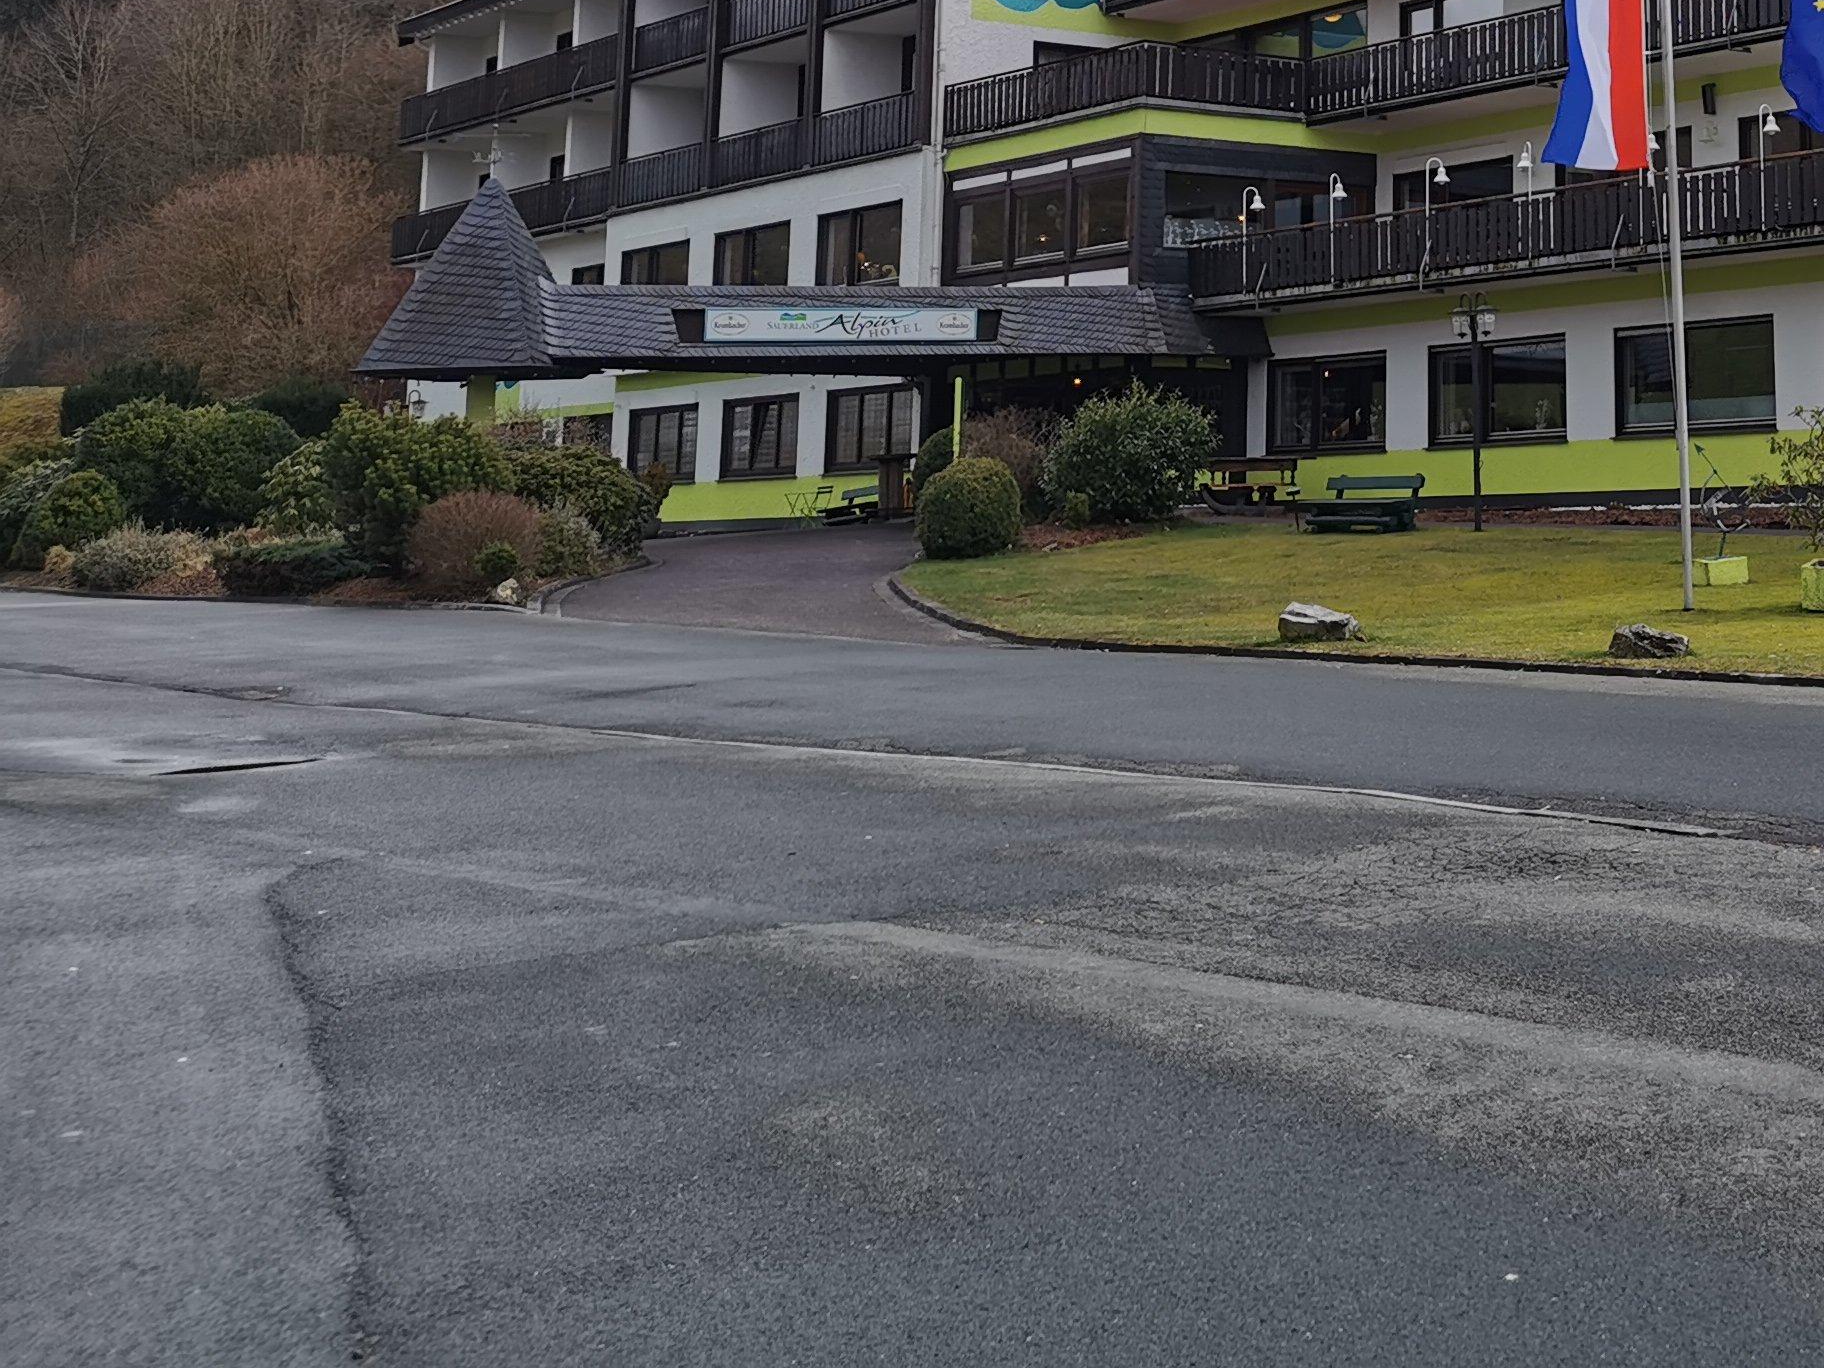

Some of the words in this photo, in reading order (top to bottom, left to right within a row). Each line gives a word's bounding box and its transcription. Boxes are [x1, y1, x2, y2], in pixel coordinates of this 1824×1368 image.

[767, 321, 819, 330] SAUERLAND
[815, 312, 903, 339] Alpin
[868, 322, 922, 338] HOTEL
